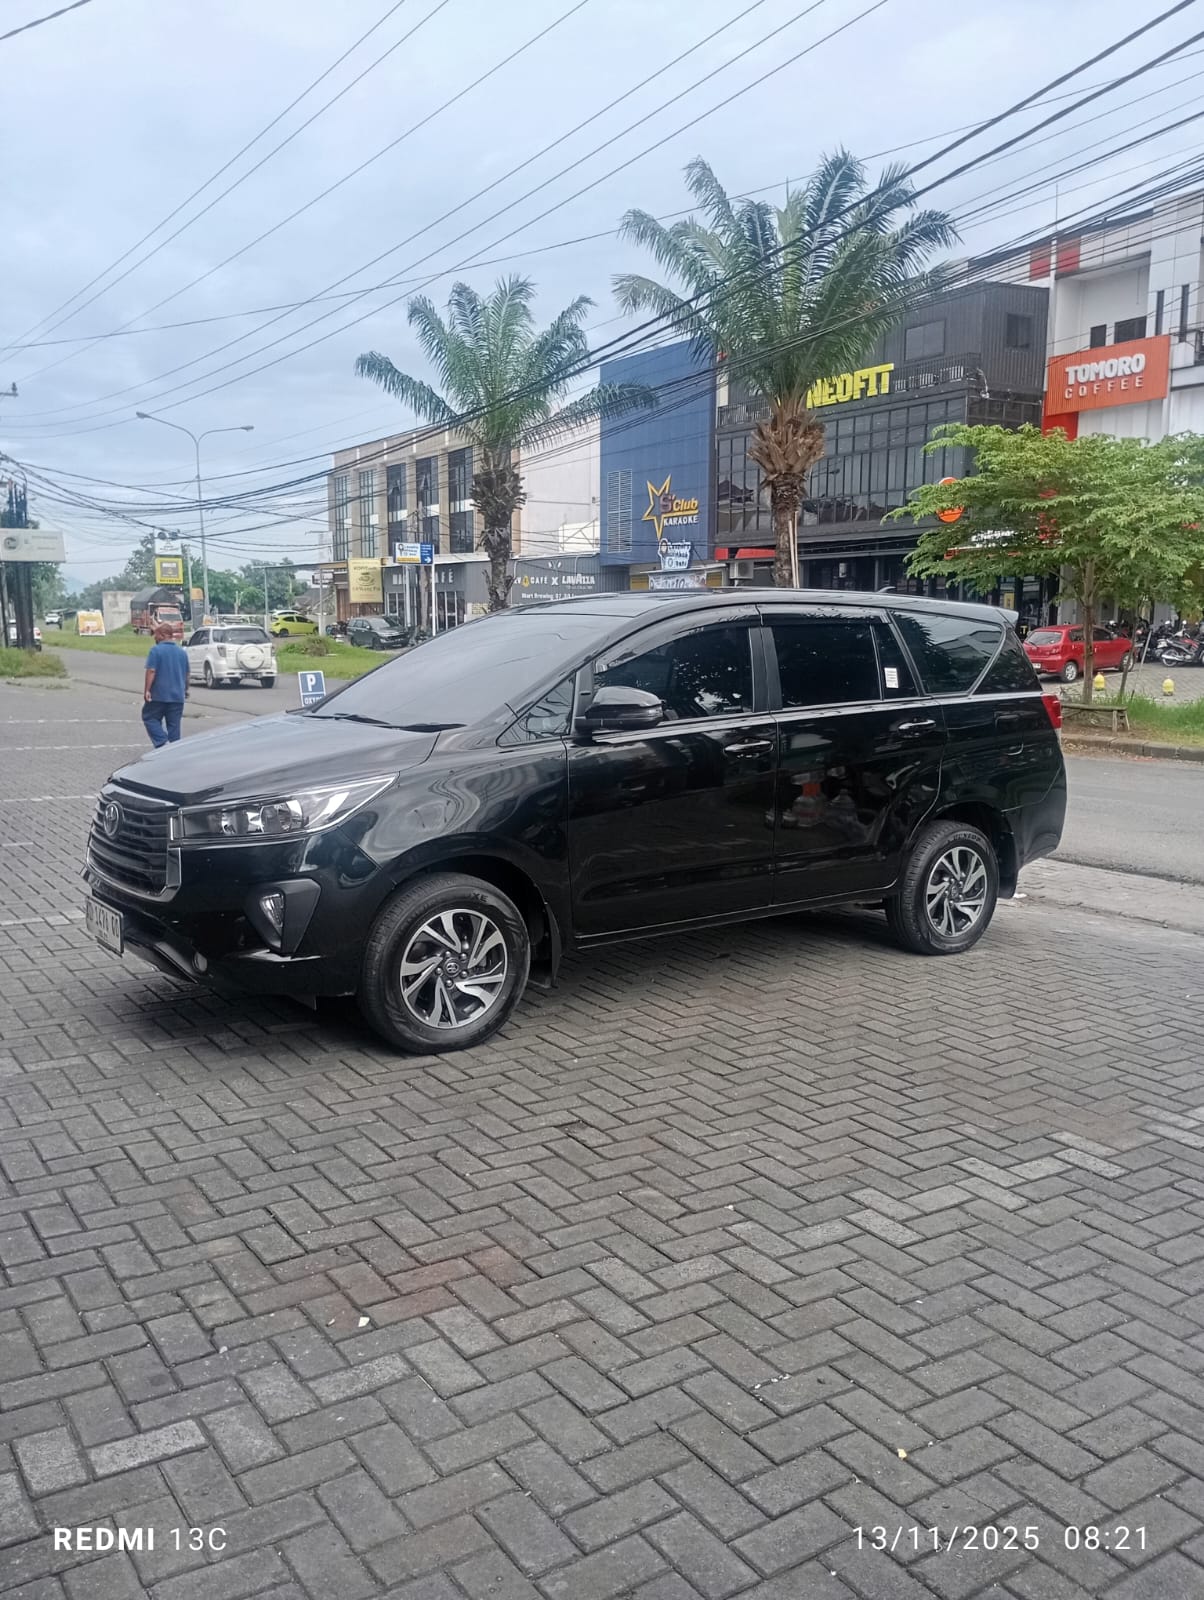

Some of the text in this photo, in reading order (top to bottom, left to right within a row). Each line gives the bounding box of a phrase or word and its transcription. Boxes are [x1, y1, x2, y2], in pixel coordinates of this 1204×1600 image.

[1065, 353, 1146, 385] TOMORO
[806, 363, 894, 409] NEOFIT
[1064, 375, 1144, 399] COFFEE
[663, 515, 699, 527] KARAOKE
[562, 573, 596, 585] LAVAZZA
[306, 674, 316, 692] P
